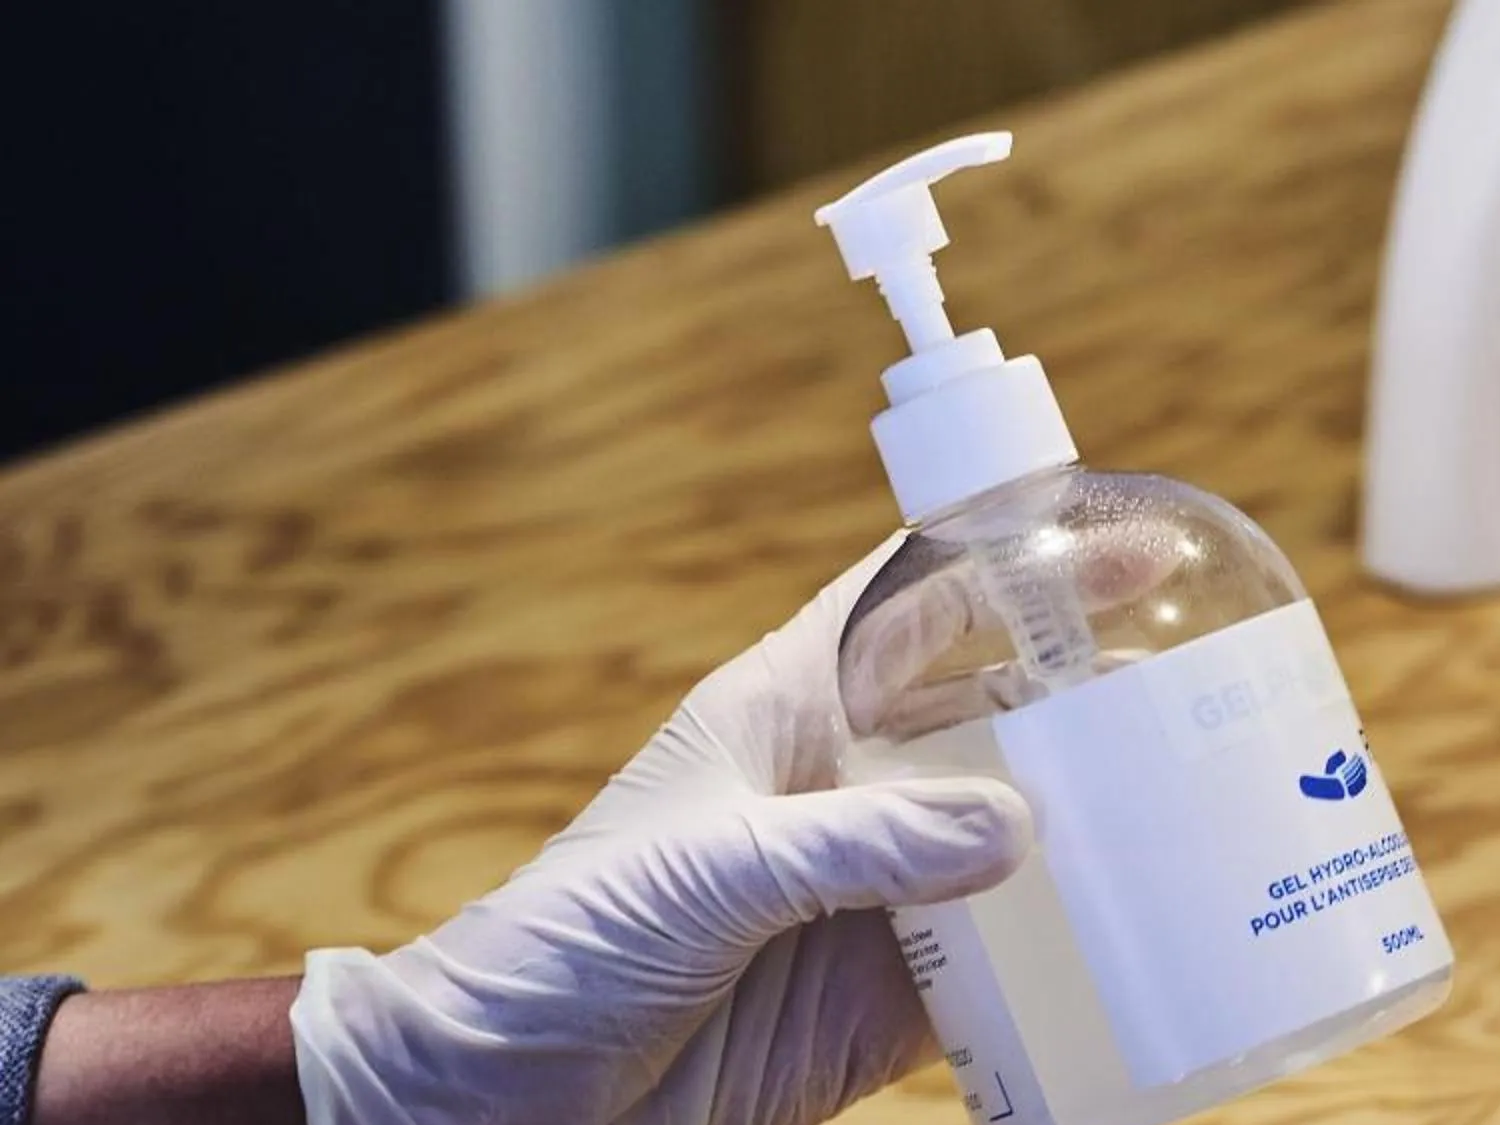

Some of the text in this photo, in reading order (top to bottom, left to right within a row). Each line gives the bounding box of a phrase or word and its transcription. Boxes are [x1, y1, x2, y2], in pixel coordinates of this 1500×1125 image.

[1268, 875, 1306, 901] GEL
[1250, 900, 1308, 936] POUR
[1382, 925, 1424, 953] 500ML
